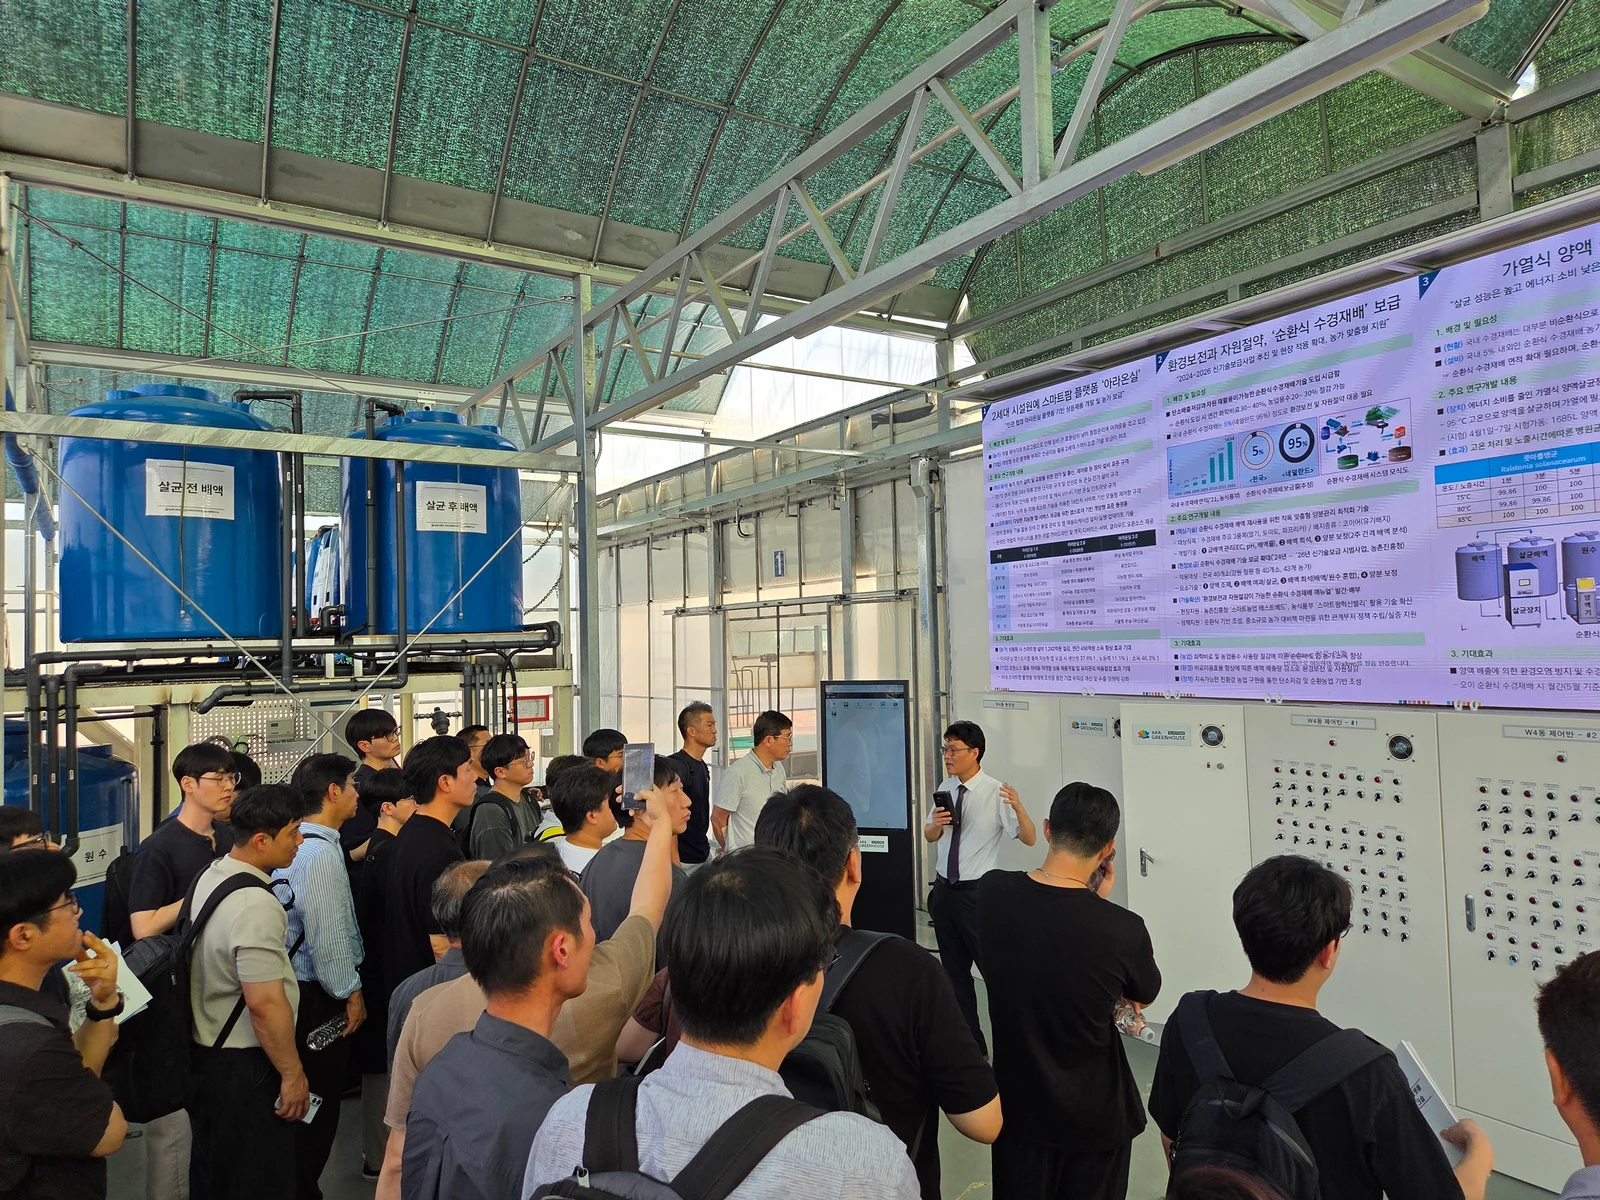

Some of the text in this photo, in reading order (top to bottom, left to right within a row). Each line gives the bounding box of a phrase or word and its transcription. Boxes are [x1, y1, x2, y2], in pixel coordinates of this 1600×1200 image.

[1502, 238, 1592, 279] 가열식 양액
[1422, 276, 1428, 286] 3
[1474, 287, 1500, 303] 성능은
[1504, 281, 1521, 295] 높고
[1525, 273, 1553, 290] 에너지
[1557, 266, 1576, 281] 소비
[1581, 260, 1600, 275] 낮은
[1167, 346, 1217, 372] 환경보전과
[1220, 332, 1266, 358] 자원절약,
[1373, 293, 1401, 316] 보급
[1436, 314, 1497, 337] 1. 배경 및 필요성
[1443, 308, 1598, 352] (현황) 국내 수경재배는 대부분 비순환식으로
[1212, 354, 1254, 374] 신기술보급사업
[1256, 350, 1269, 362] 추진
[1271, 348, 1277, 358] 및
[1280, 344, 1293, 356] 현장
[1295, 340, 1309, 352] 적용
[1311, 334, 1327, 347] 확대,
[1329, 330, 1344, 343] 농가
[1346, 323, 1368, 338] 맞춤형
[1444, 326, 1583, 365] (설비) 국내 5% 내외인 순환식 수경재배
[1158, 355, 1162, 363] 2
[1452, 342, 1578, 378] 순환식 수경재배 면적 확대 필요하며,
[1438, 375, 1516, 399] 2. 주요 연구개발 내용
[992, 408, 1009, 421] 2세대
[1011, 398, 1040, 416] 시설원예
[1042, 389, 1071, 407] 스마트팜
[1074, 382, 1098, 398] 플랫폼
[1172, 394, 1182, 402] 배경
[1190, 388, 1206, 398] 필요성
[1446, 403, 1465, 414] (장치)
[1468, 399, 1489, 410] 에너지
[1492, 394, 1514, 405] 소비를
[1518, 390, 1532, 400] 줄인
[1535, 385, 1558, 397] 가열식
[1447, 431, 1467, 442] (시험)
[1514, 417, 1547, 430] 시험가동:
[1551, 412, 1577, 424] 1685L
[1581, 408, 1597, 419] 양액
[1252, 444, 1264, 456] 5%
[1288, 435, 1308, 450] 95%
[1448, 445, 1467, 455] (효과)
[1471, 442, 1484, 452] 고온
[1487, 439, 1502, 449] 처리
[1504, 438, 1512, 446] 및
[1501, 455, 1586, 473] Ralstonia solanacearum
[1249, 473, 1267, 483] <한국>
[1281, 466, 1314, 478] <네덜란드>
[158, 481, 224, 496] 살균 전 배액
[1460, 480, 1485, 489] 노출시간
[1498, 487, 1516, 495] 99.86
[426, 500, 478, 512] 살균 후 배액
[1532, 495, 1551, 504] 99.86
[1188, 511, 1208, 520] 연구개발
[1518, 549, 1547, 558] 살균배액
[1581, 546, 1596, 554] 원수
[776, 552, 782, 574] 1
[1575, 630, 1600, 638] 순환식
[1524, 729, 1546, 737] W4동
[1549, 730, 1574, 738] 제어반
[84, 848, 107, 862] 원 수
